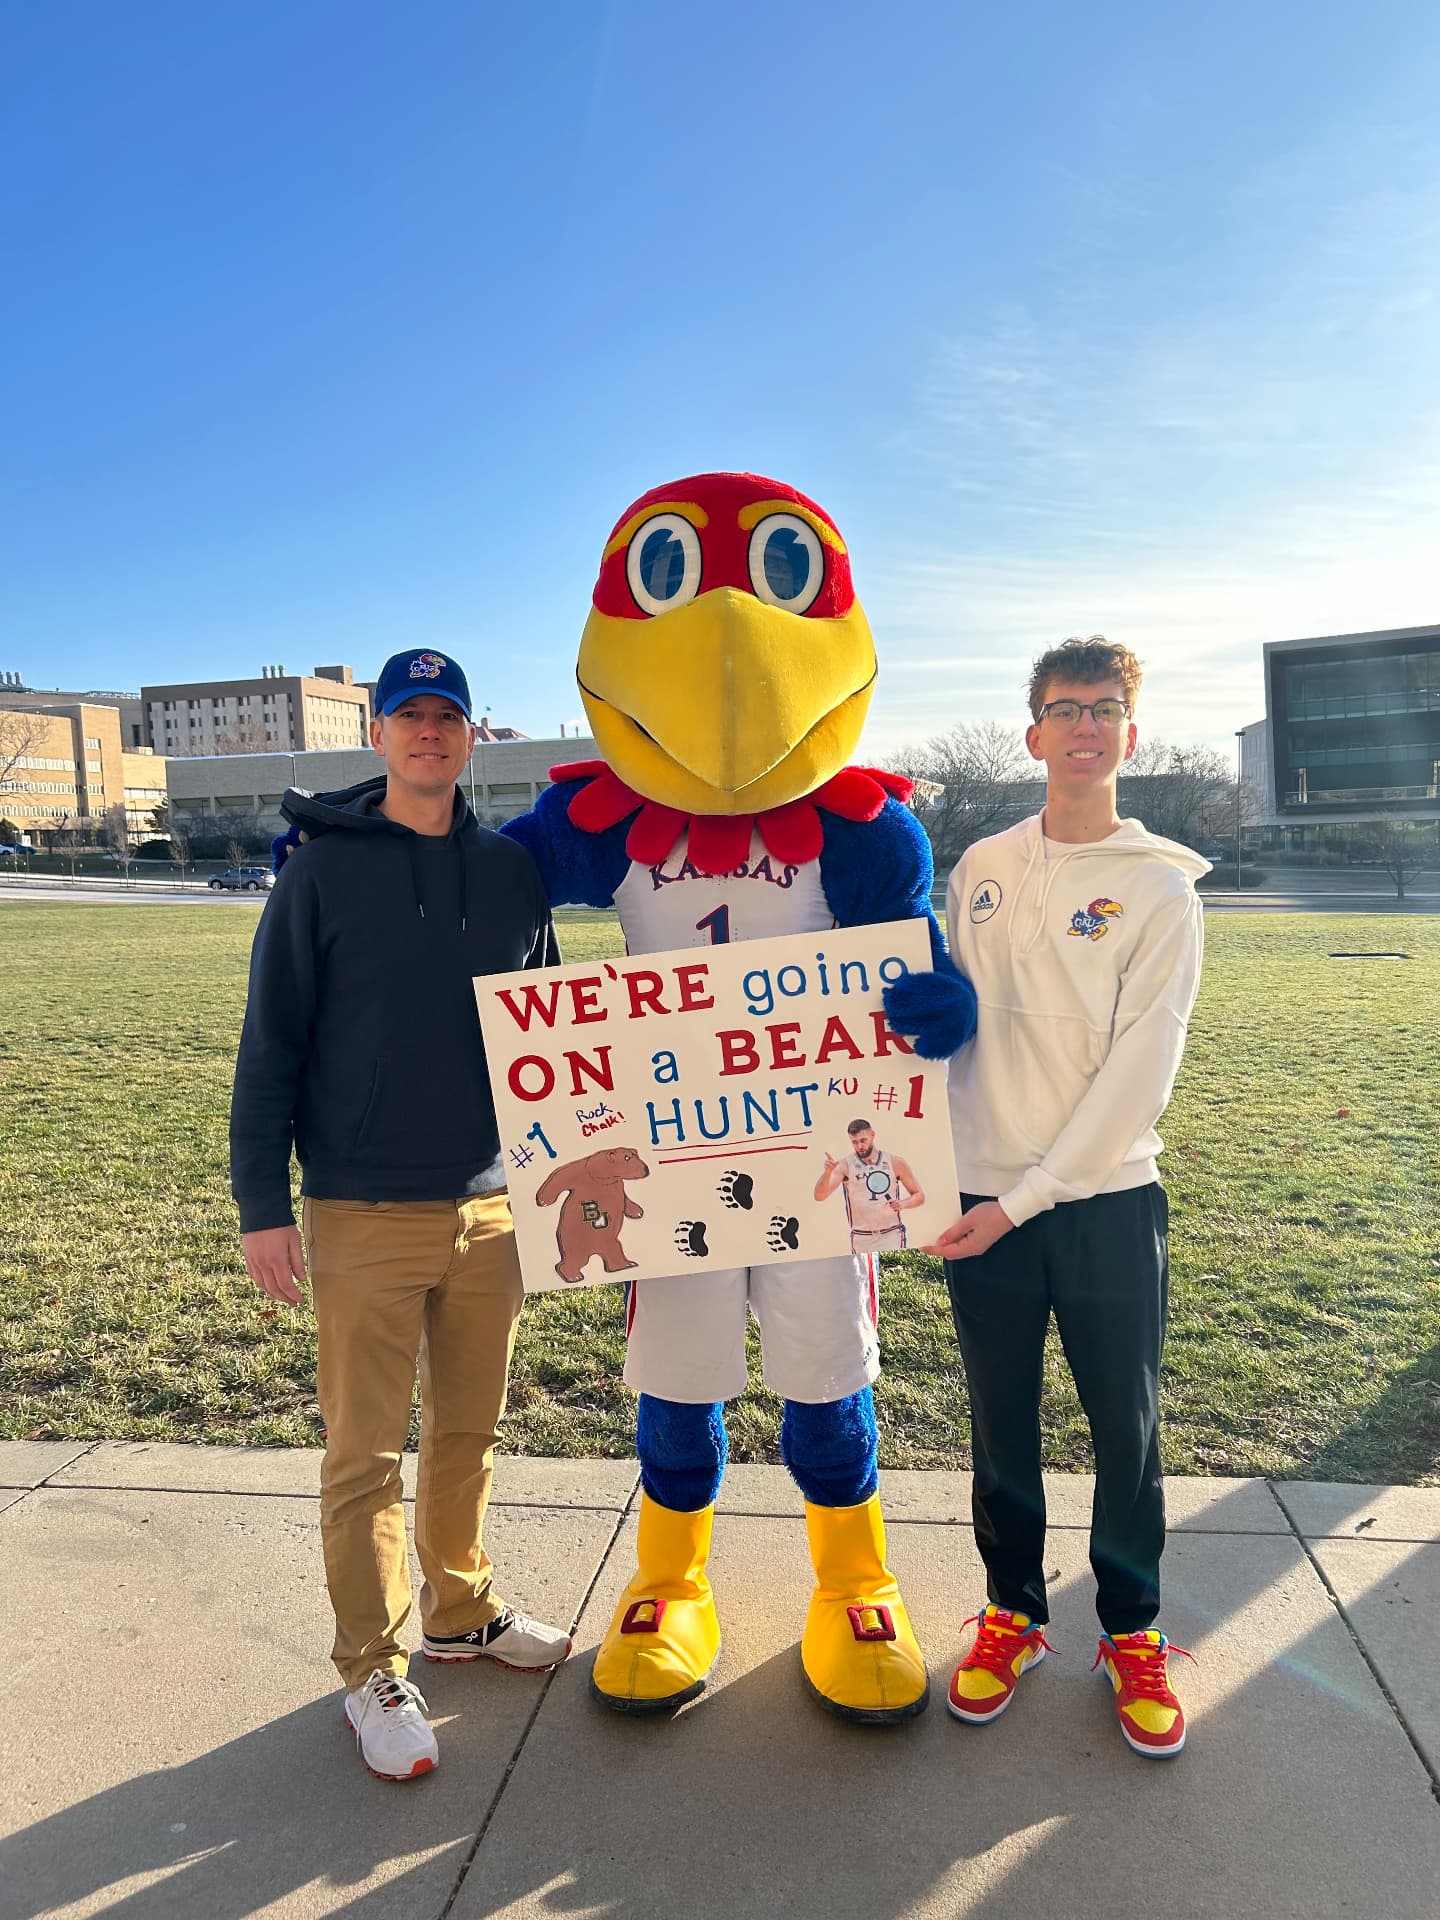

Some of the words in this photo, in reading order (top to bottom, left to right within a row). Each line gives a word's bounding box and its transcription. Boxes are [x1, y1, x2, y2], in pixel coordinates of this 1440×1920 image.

[649, 855, 799, 891] KASAS
[696, 904, 730, 945] 1
[494, 963, 715, 1032] WE'RE
[743, 952, 909, 1016] going
[508, 1045, 614, 1102] ON
[651, 1050, 679, 1084] a
[576, 1102, 613, 1123] Rock
[646, 1082, 818, 1145] HUNT
[828, 1077, 858, 1096] KU
[873, 1074, 924, 1119] #1
[510, 1121, 557, 1169] #1
[581, 1111, 626, 1137] Chalk!
[581, 1201, 609, 1229] BU
